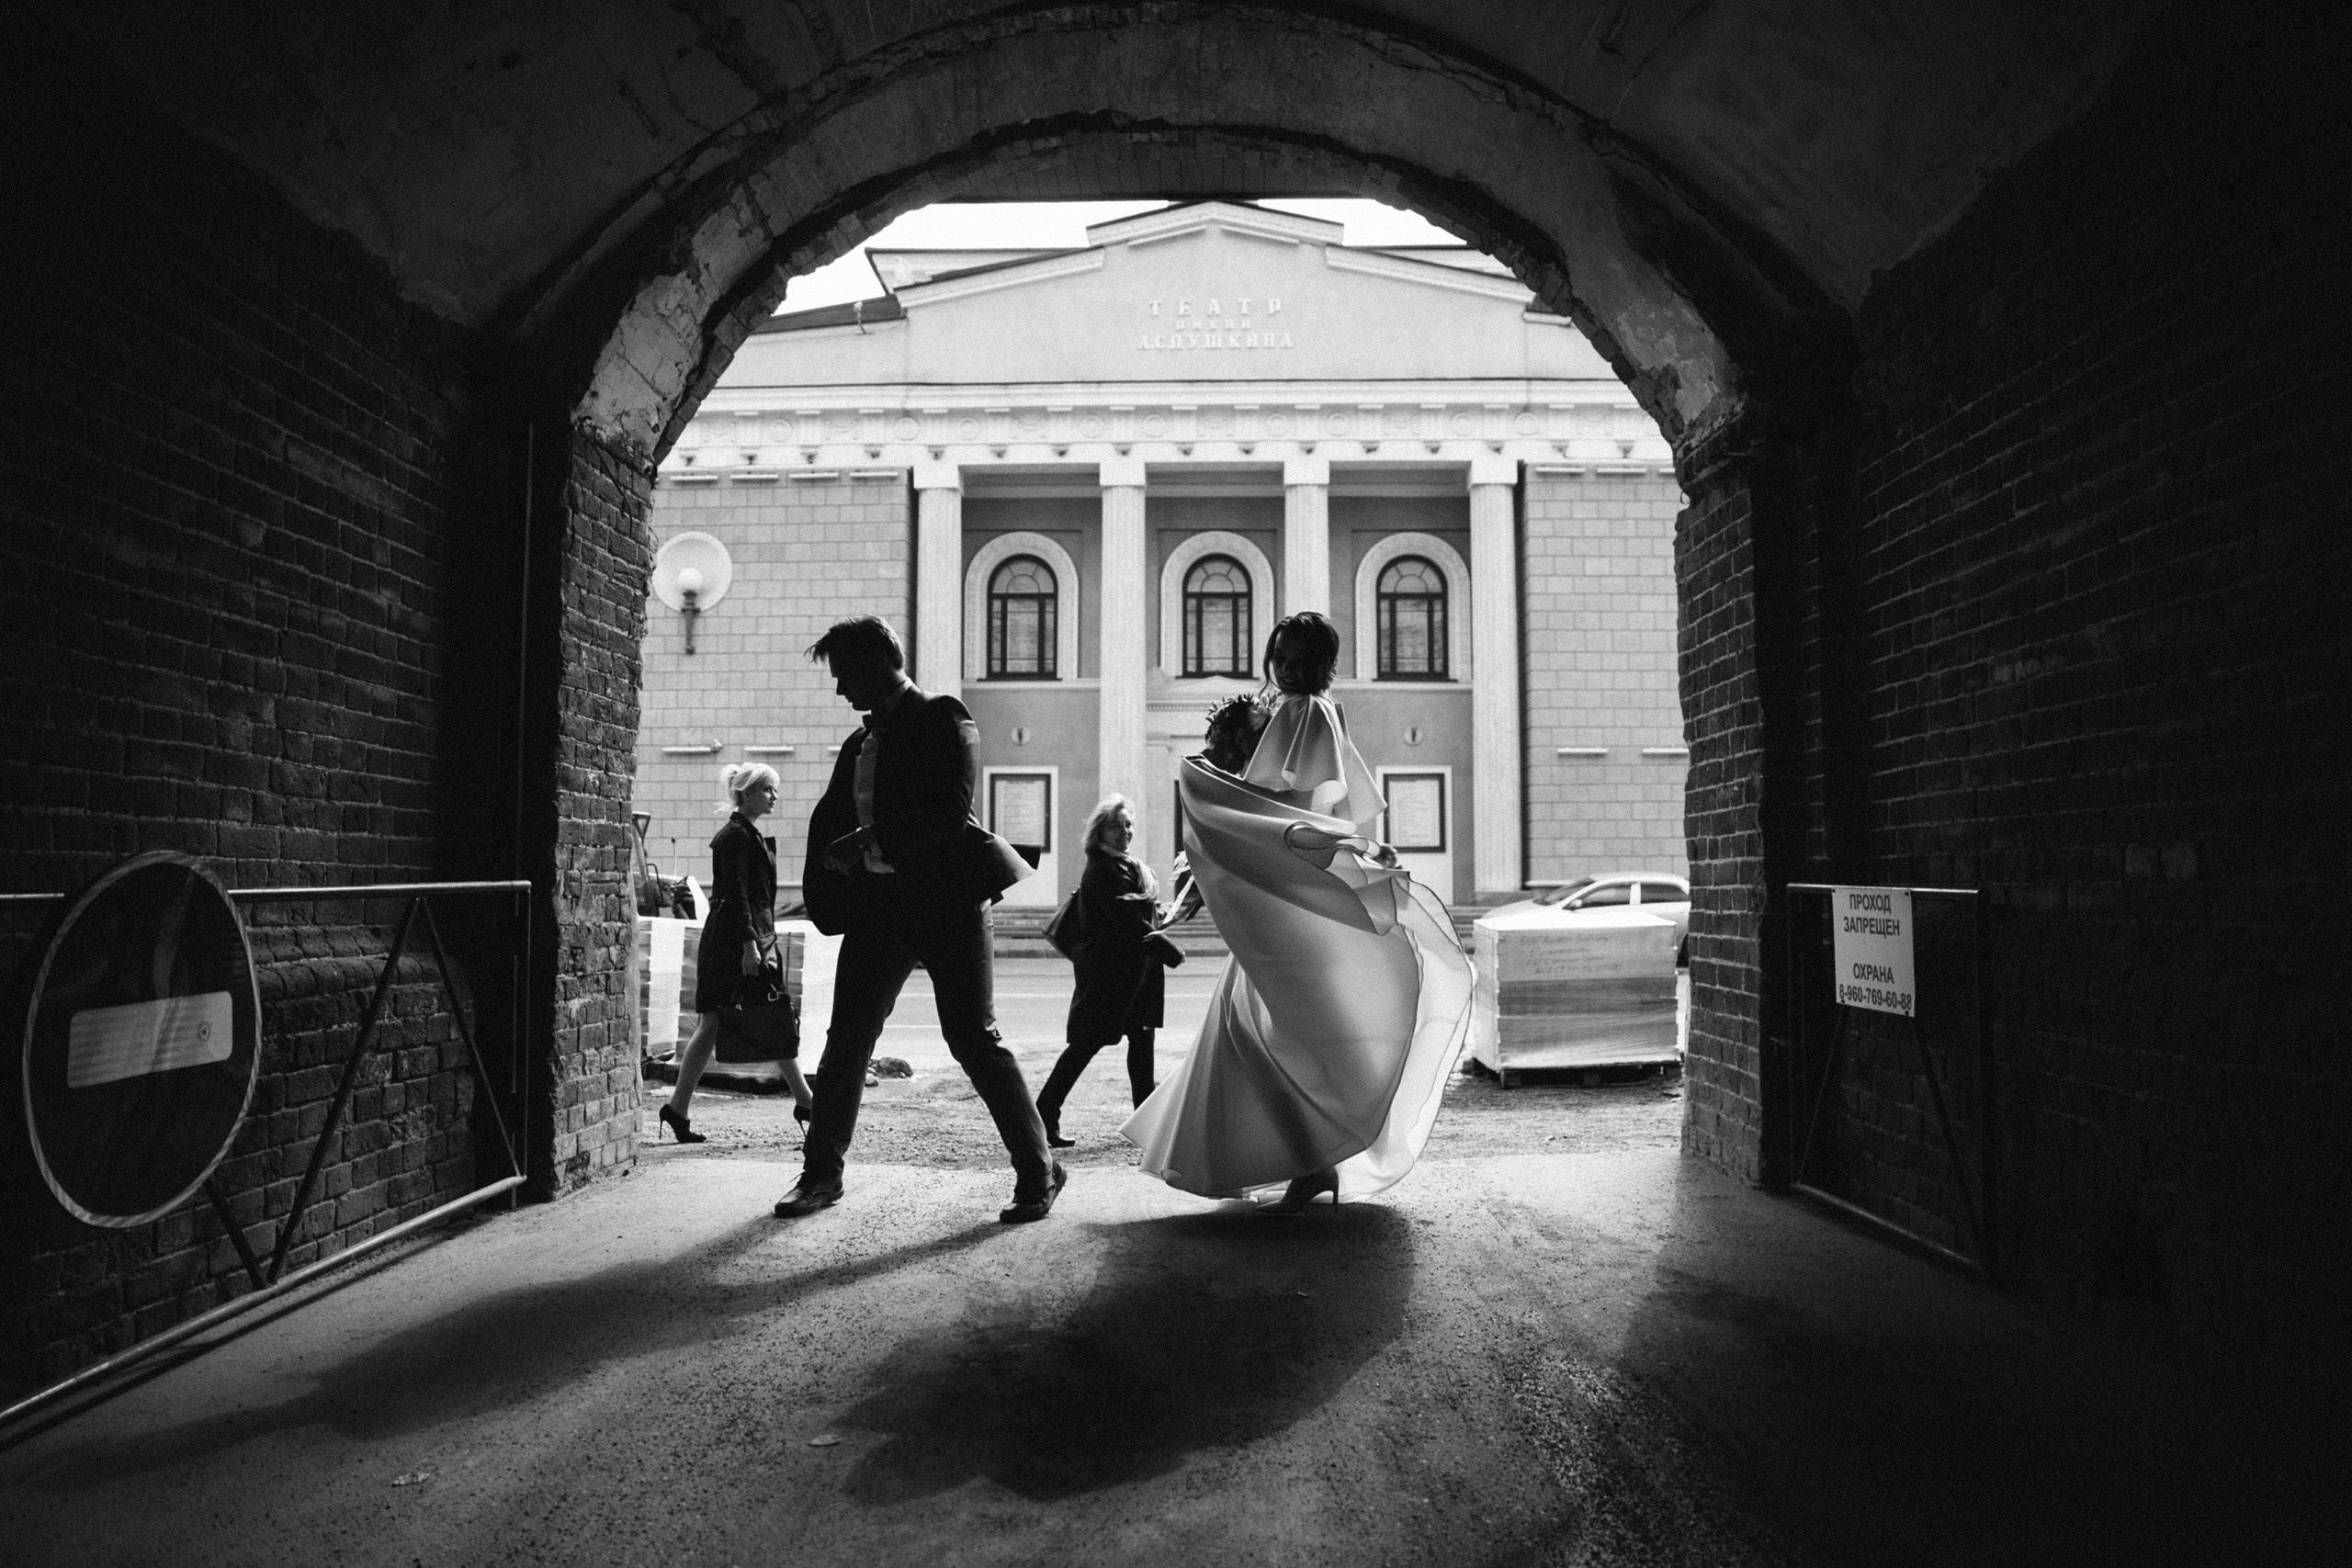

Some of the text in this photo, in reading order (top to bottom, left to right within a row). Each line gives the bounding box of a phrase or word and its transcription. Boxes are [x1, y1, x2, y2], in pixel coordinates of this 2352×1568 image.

[1149, 298, 1282, 316] ТЕАТР
[1849, 894, 1891, 914] ПРОХОД
[1843, 916, 1900, 938] ЗАПРЕЩЕН
[1853, 963, 1894, 984] ОХРАНА
[1839, 984, 1912, 1010] 8-960-769-60-88
